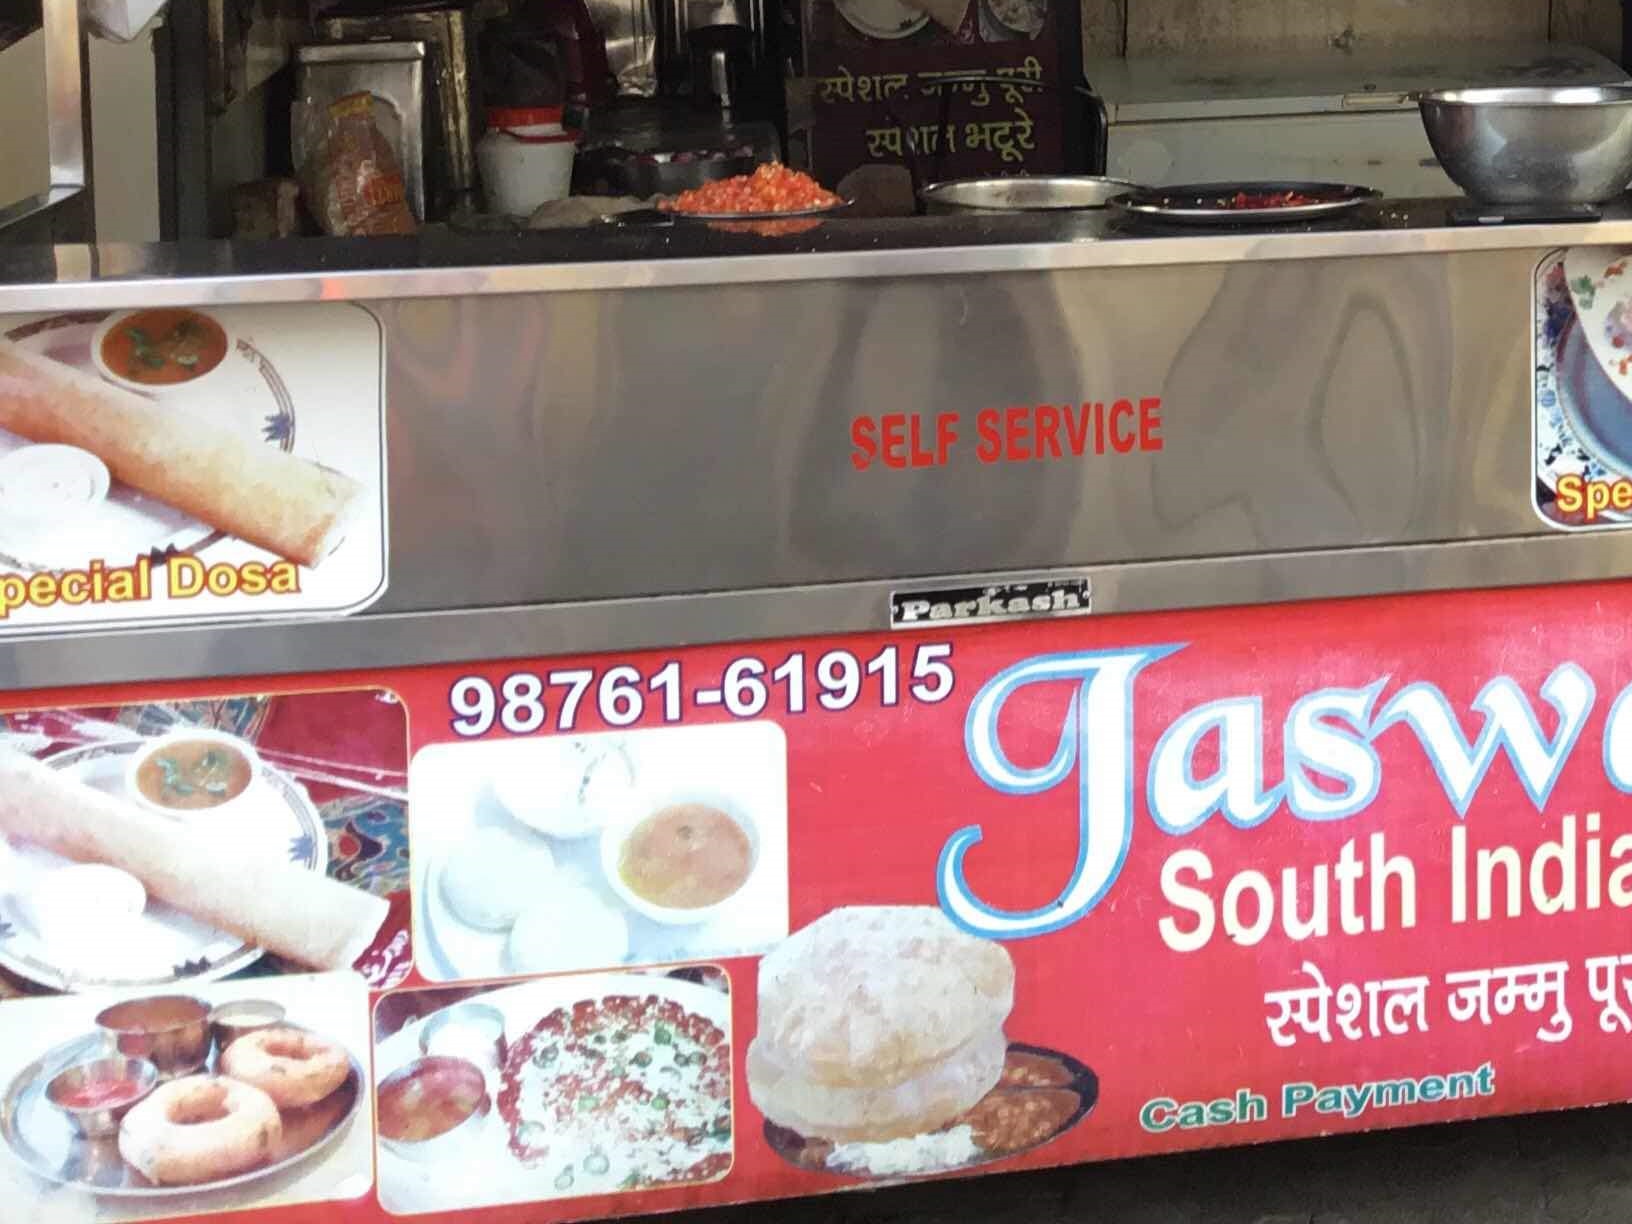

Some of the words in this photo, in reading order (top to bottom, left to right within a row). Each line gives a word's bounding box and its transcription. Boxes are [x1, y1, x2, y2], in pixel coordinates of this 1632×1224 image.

[964, 107, 1036, 162] भटूरे
[850, 412, 959, 471] SELF
[976, 397, 1163, 465] SERVICE
[167, 554, 301, 598] Dosa
[449, 642, 956, 738] 98761-61915
[1157, 829, 1417, 952] South
[1265, 960, 1429, 1048] स्पेशल
[1447, 961, 1571, 1043] जम्मु
[1140, 1094, 1267, 1134] Cash
[1283, 1061, 1497, 1121] Payment
